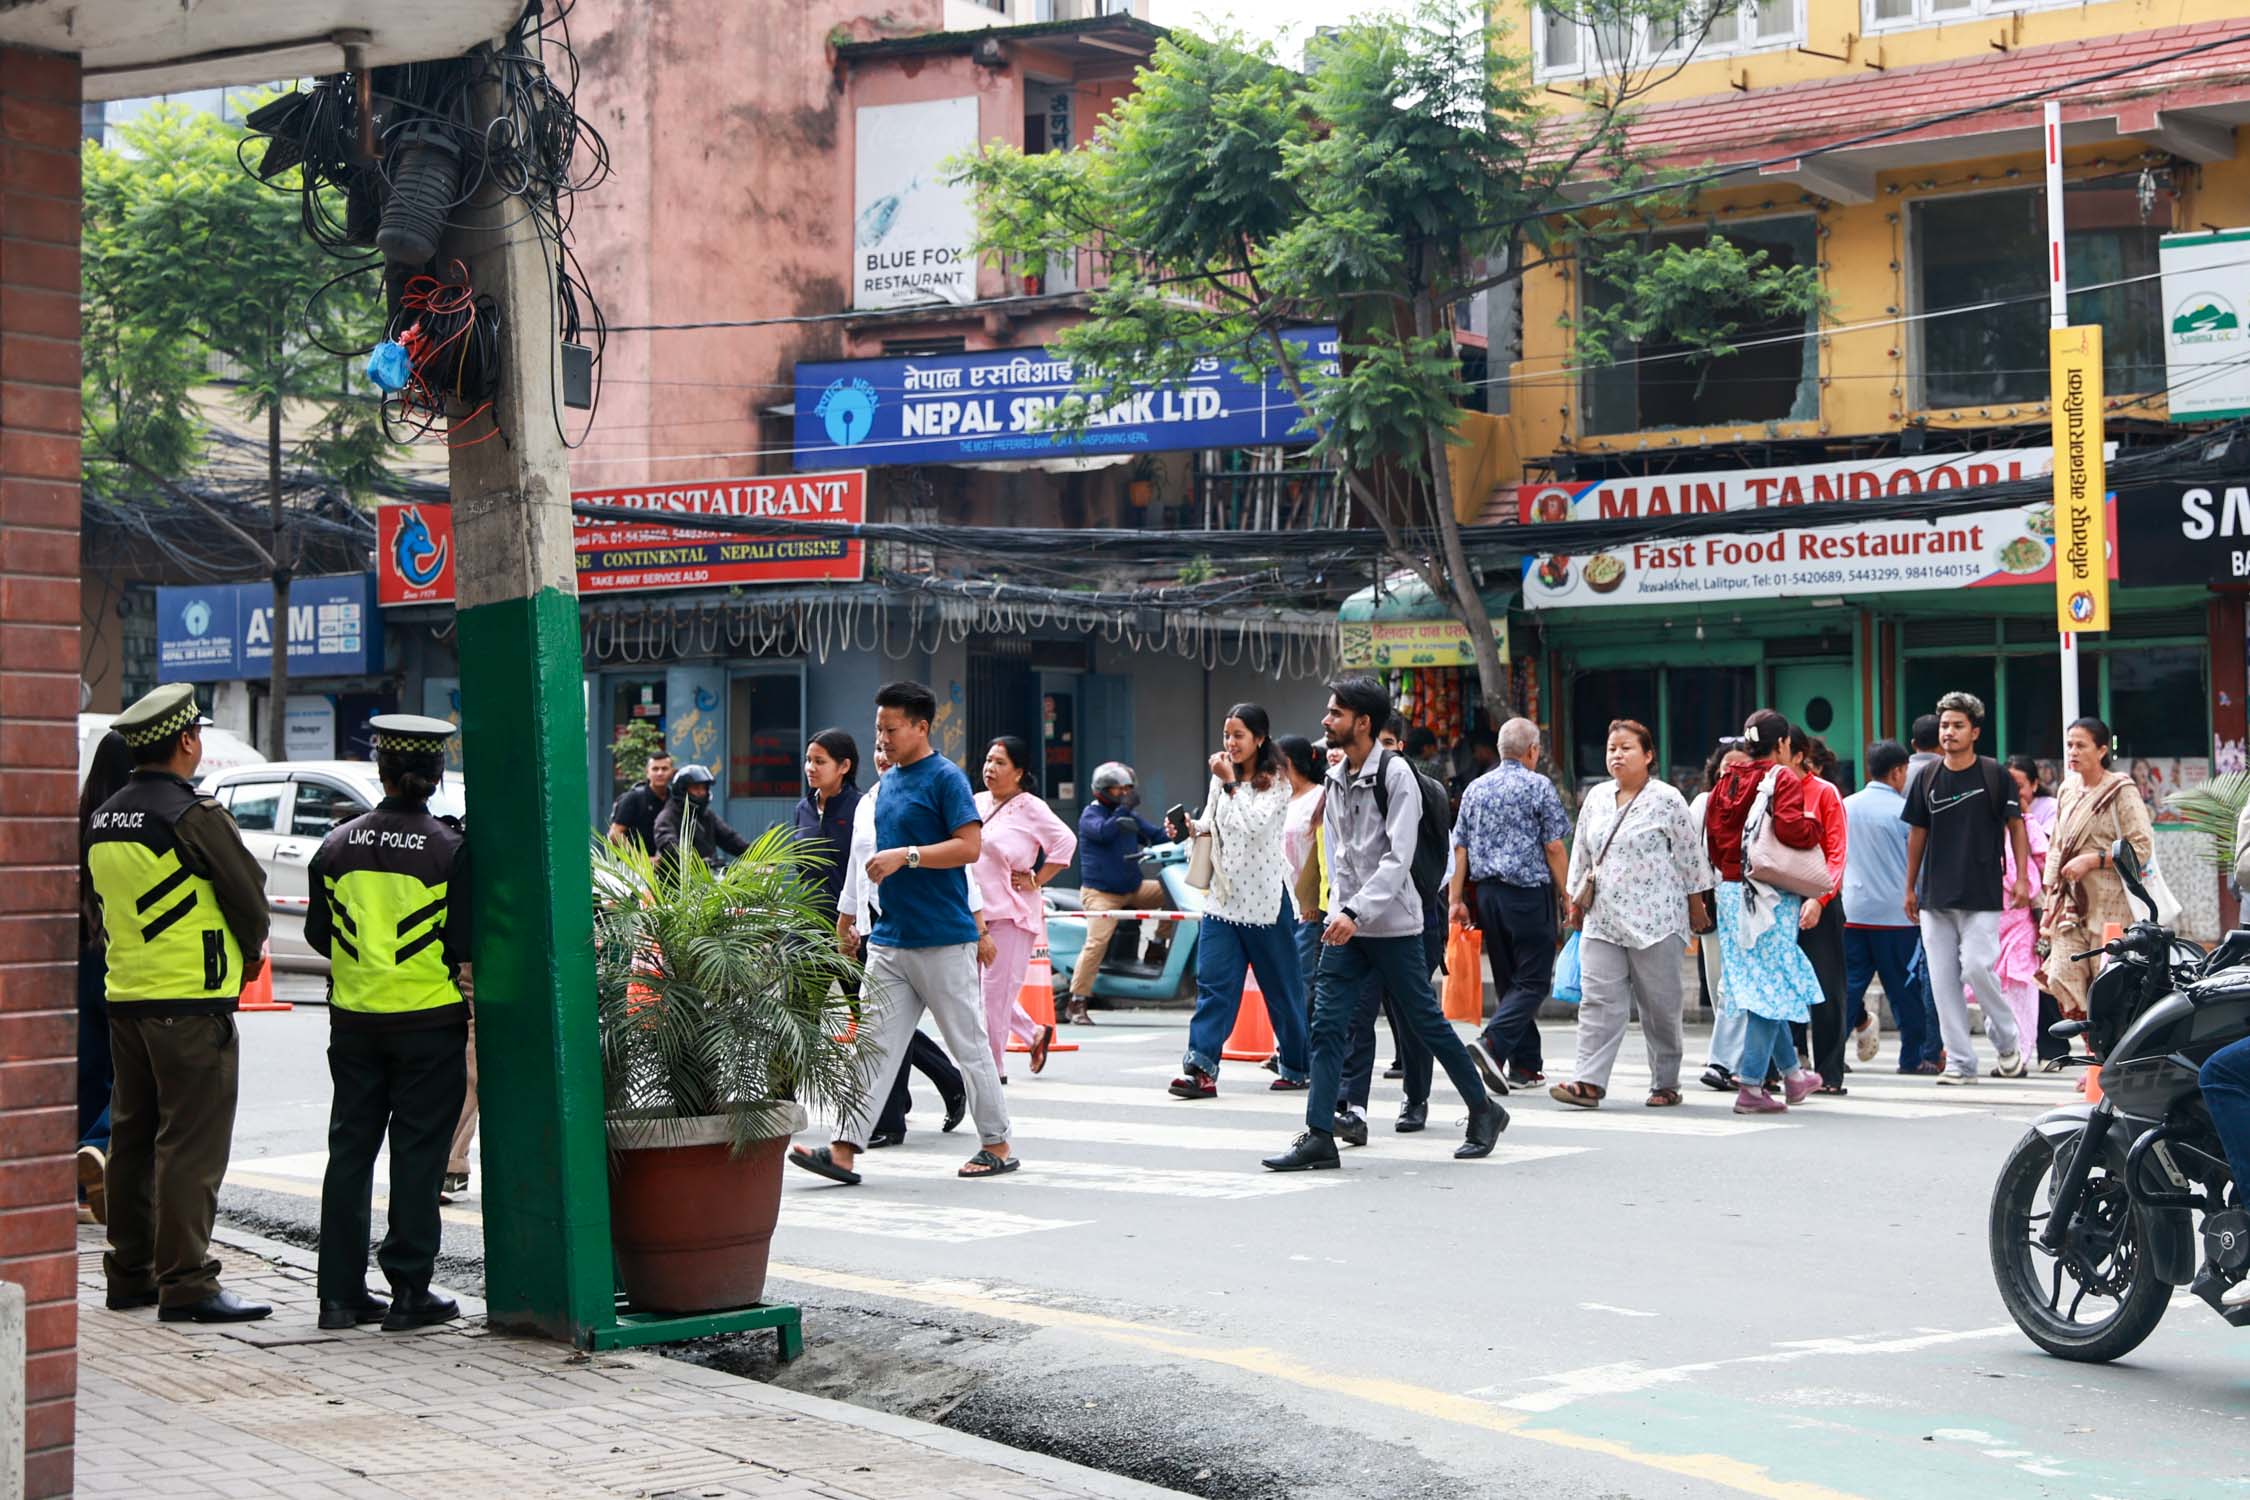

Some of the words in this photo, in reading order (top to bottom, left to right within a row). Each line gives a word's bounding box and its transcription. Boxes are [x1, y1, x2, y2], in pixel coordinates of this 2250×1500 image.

[867, 250, 916, 271] BLUE
[923, 248, 962, 266] FOX
[864, 271, 965, 292] RESTAURANT
[903, 365, 962, 390] नेपाल
[902, 399, 1003, 437] NEPAL
[1163, 386, 1229, 422] LTD.
[2063, 368, 2087, 500] महानगरपालिका
[622, 481, 849, 524] RESTAURANT
[1598, 482, 1726, 520] MAIN
[602, 546, 708, 567] CONTINENTAL
[777, 540, 841, 558] CUISINE
[1633, 542, 1696, 570] Fast
[1706, 532, 1786, 565] Food
[1798, 524, 1984, 561] Restaurant
[2066, 506, 2092, 580] ललितपुर
[591, 575, 614, 587] TAKE
[615, 574, 641, 585] AWAY
[642, 572, 681, 584] SERVICE
[682, 570, 709, 582] ALSO
[1704, 576, 1749, 592] Lalitpur,
[1752, 573, 1772, 587] Tel:
[1774, 568, 1846, 586] 01-5420689,
[1848, 566, 1902, 583] 5443299,
[1905, 564, 1981, 580] 9841640154
[92, 812, 109, 829] LMC
[111, 812, 145, 828] POLICE
[348, 829, 375, 846] LMC
[380, 832, 427, 850] POLICE
